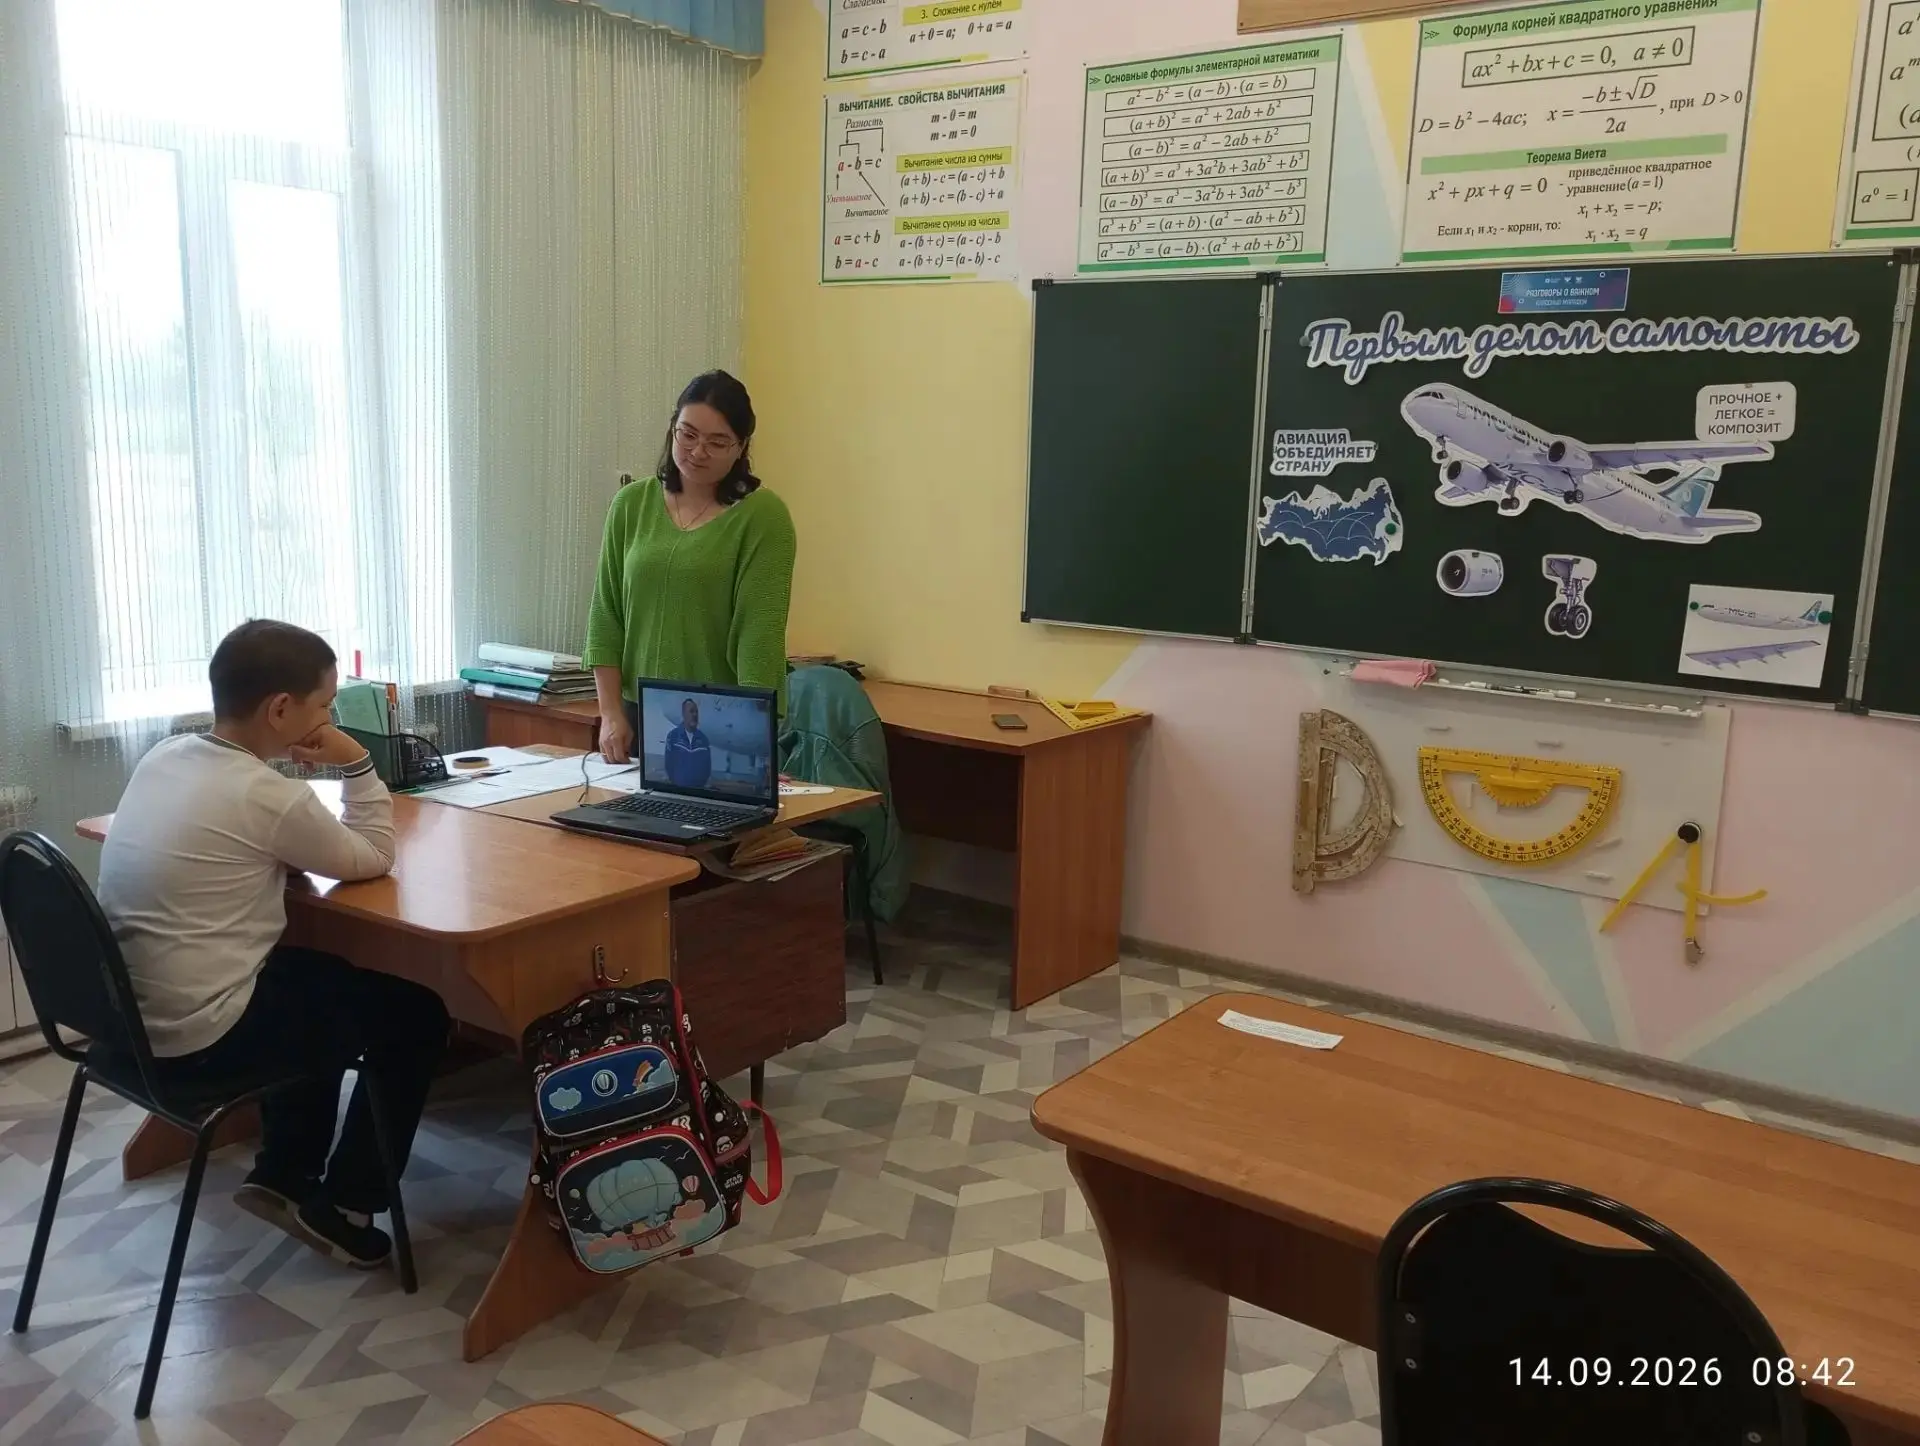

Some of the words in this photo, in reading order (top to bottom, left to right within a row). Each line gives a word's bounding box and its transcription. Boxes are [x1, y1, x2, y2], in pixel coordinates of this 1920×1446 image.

[933, 6, 969, 17] Сложение
[1453, 20, 1508, 39] Формула
[1511, 14, 1557, 33] корней
[1559, 5, 1641, 27] квадратного
[1104, 69, 1148, 85] Основные
[1150, 65, 1193, 81] формулы
[1195, 56, 1261, 73] элементарной
[1263, 48, 1320, 64] математики
[839, 97, 893, 112] ВЫЧИТАНИЕ.
[898, 89, 944, 106] СВОЙСТВА
[947, 84, 1005, 100] ВЫЧИТАНИЯ
[1669, 96, 1695, 111] при
[845, 118, 883, 129] Разность
[1604, 117, 1626, 134] 2a
[904, 158, 943, 169] Вычитание
[945, 156, 967, 166] числа
[968, 155, 977, 164] из
[978, 152, 1003, 163] суммы
[1526, 150, 1572, 165] Теорема
[1574, 148, 1607, 161] Виета
[1568, 164, 1643, 180] приведённое
[1645, 158, 1712, 174] квадратное
[1567, 181, 1626, 198] уравнение
[902, 220, 941, 231] Вычитание
[942, 219, 967, 229] суммы
[968, 218, 977, 227] из
[978, 217, 1001, 226] числа
[1438, 224, 1463, 237] Если
[1507, 222, 1543, 235] корни,
[1545, 221, 1561, 231] то:
[1309, 313, 1469, 380] Первым
[1474, 323, 1601, 375] делом
[1606, 318, 1853, 350] самолеты
[1709, 392, 1771, 405] ПРОЧНОЕ
[1715, 408, 1764, 420] ЛЕГКОЕ
[1709, 423, 1781, 435] КОМПОЗИТ
[1277, 433, 1347, 446] АВИАЦИЯ
[1277, 447, 1373, 460] ОБЪЕДИНЯЕТ
[1275, 461, 1331, 472] СТРАНУ
